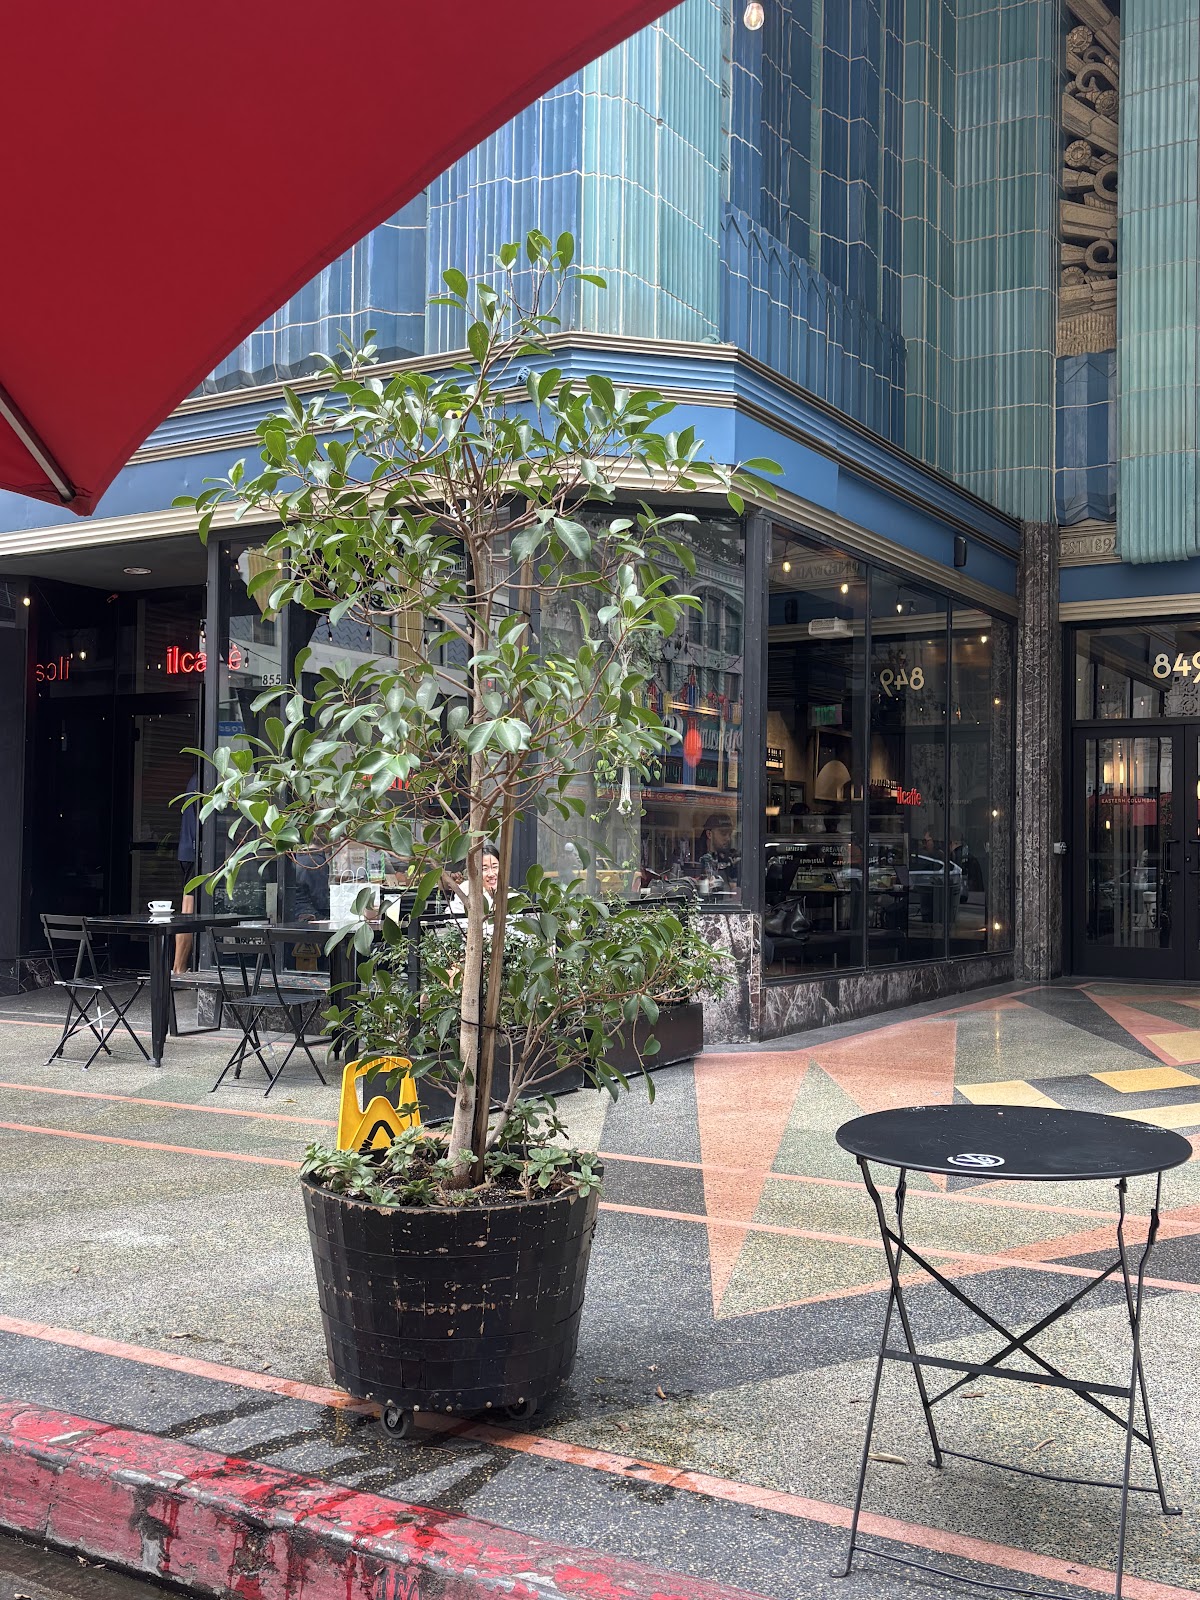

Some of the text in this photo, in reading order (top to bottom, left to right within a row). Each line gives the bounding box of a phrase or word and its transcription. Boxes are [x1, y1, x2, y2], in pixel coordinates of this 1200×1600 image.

[1089, 537, 1116, 553] 189
[1153, 651, 1200, 684] 849
[262, 674, 281, 686] 855
